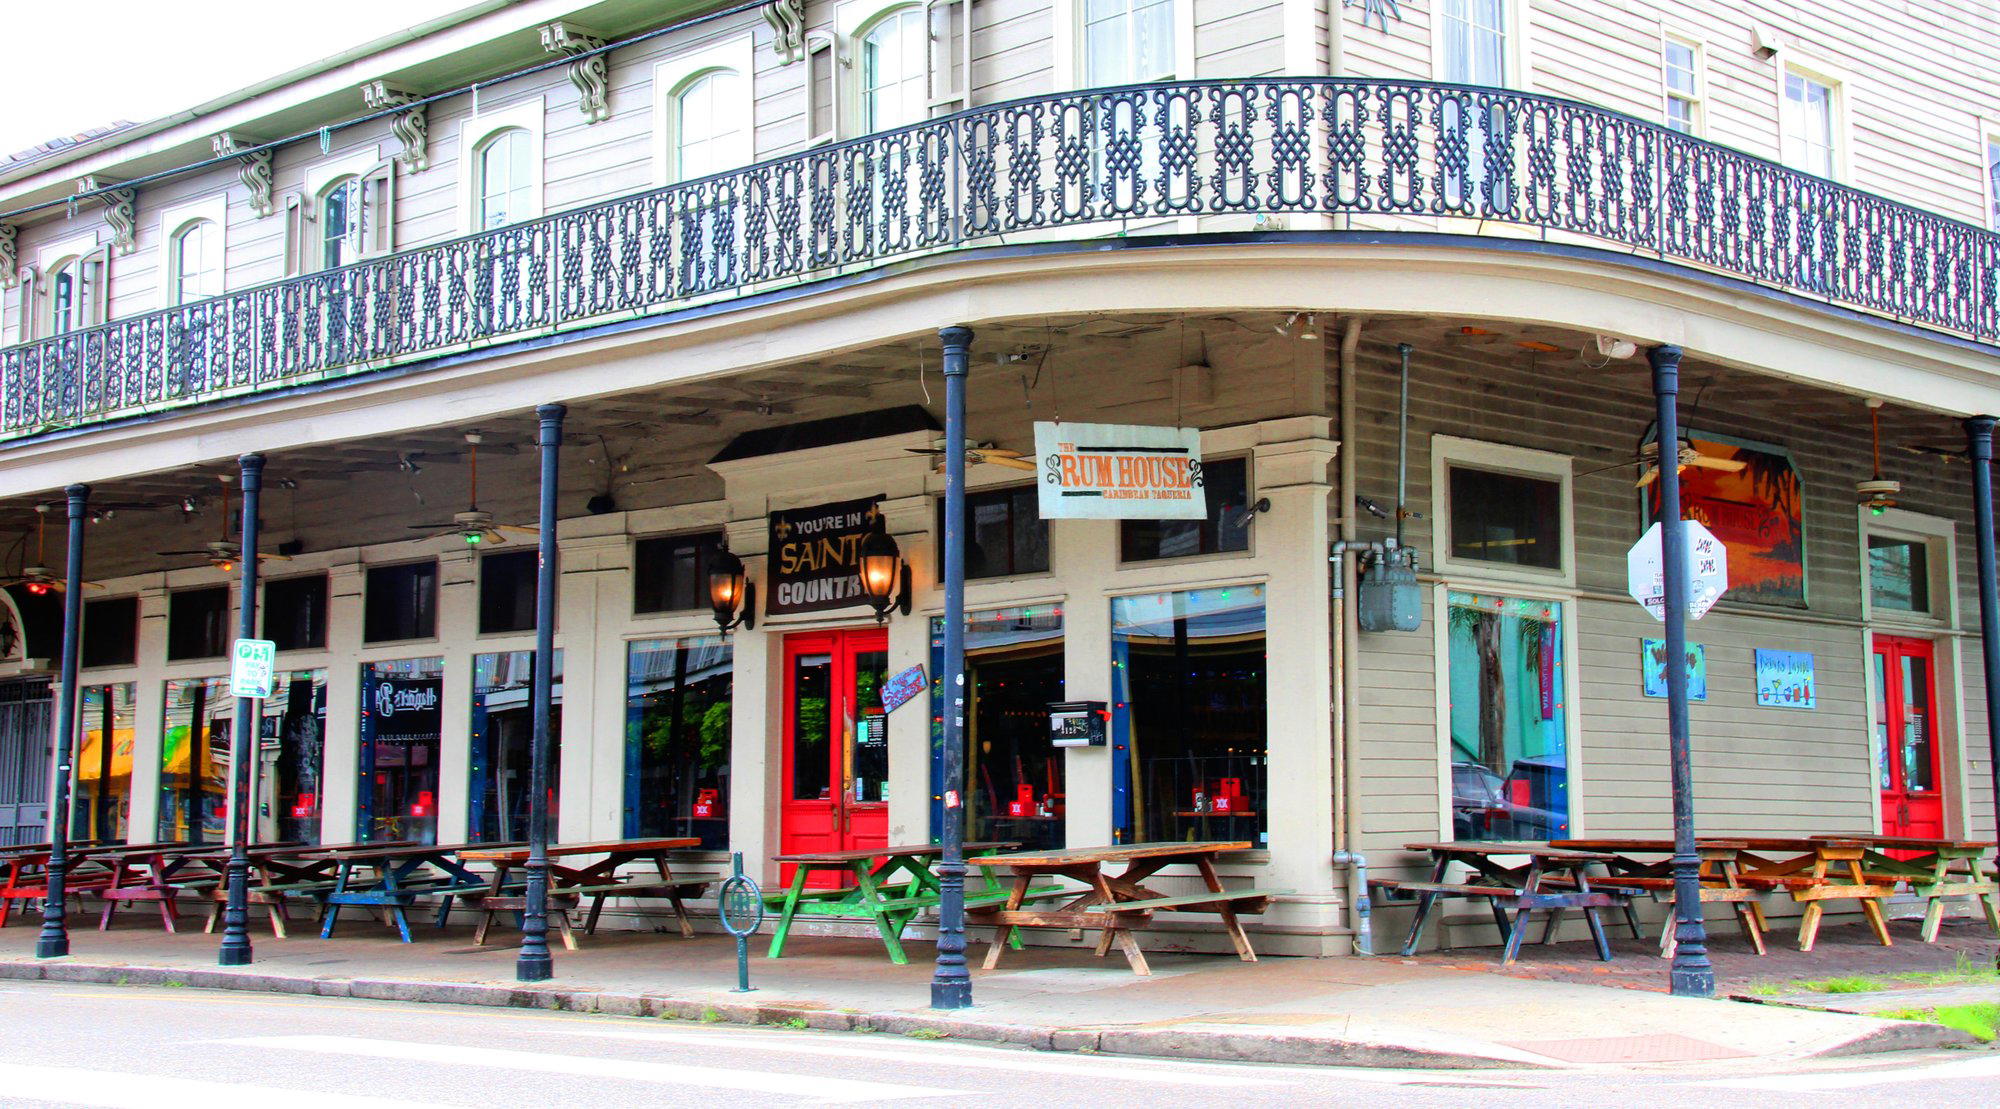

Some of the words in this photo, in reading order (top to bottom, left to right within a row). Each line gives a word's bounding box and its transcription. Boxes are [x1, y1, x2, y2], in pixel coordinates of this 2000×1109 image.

[1057, 442, 1075, 453] THE
[1059, 454, 1115, 487] RUM
[1117, 456, 1192, 488] HOUSE
[1103, 490, 1150, 499] CARIBBEAN
[1153, 490, 1192, 499] TAQUERIA
[795, 515, 844, 534] YOU'RE
[847, 512, 861, 526] IN
[780, 533, 865, 574] SAINT
[777, 574, 866, 605] COUNTR
